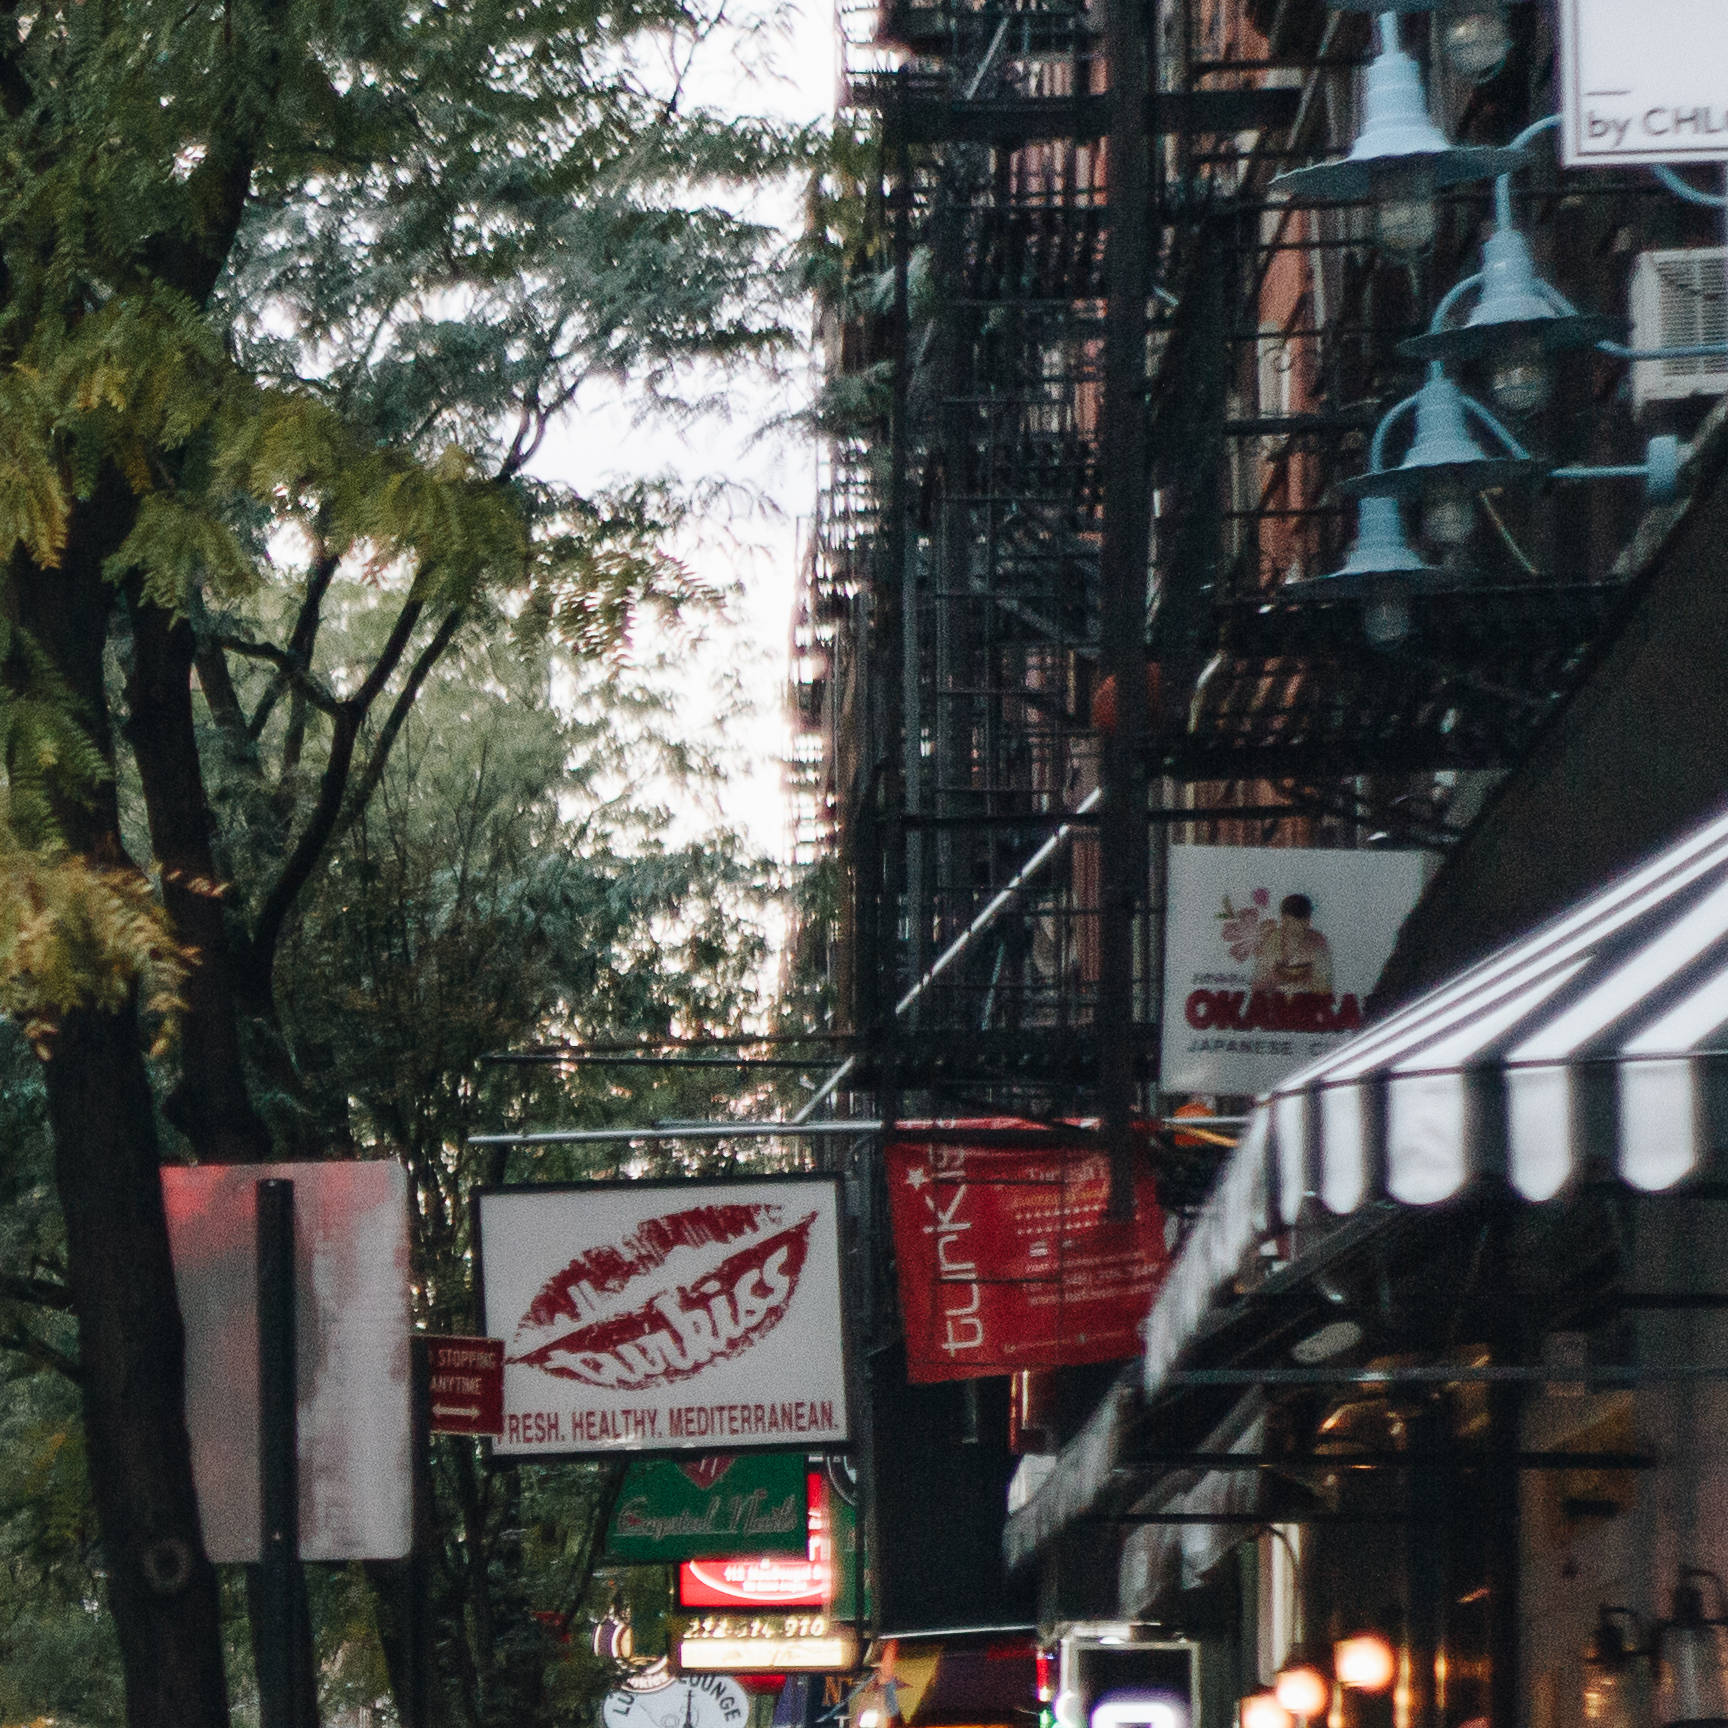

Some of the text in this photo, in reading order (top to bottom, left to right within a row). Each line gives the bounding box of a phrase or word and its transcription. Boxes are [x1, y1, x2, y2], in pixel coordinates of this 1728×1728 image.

[1587, 106, 1728, 147] by CHL
[572, 1406, 663, 1441] HEALTHY.
[668, 1400, 839, 1437] MEDITERRANEAN.
